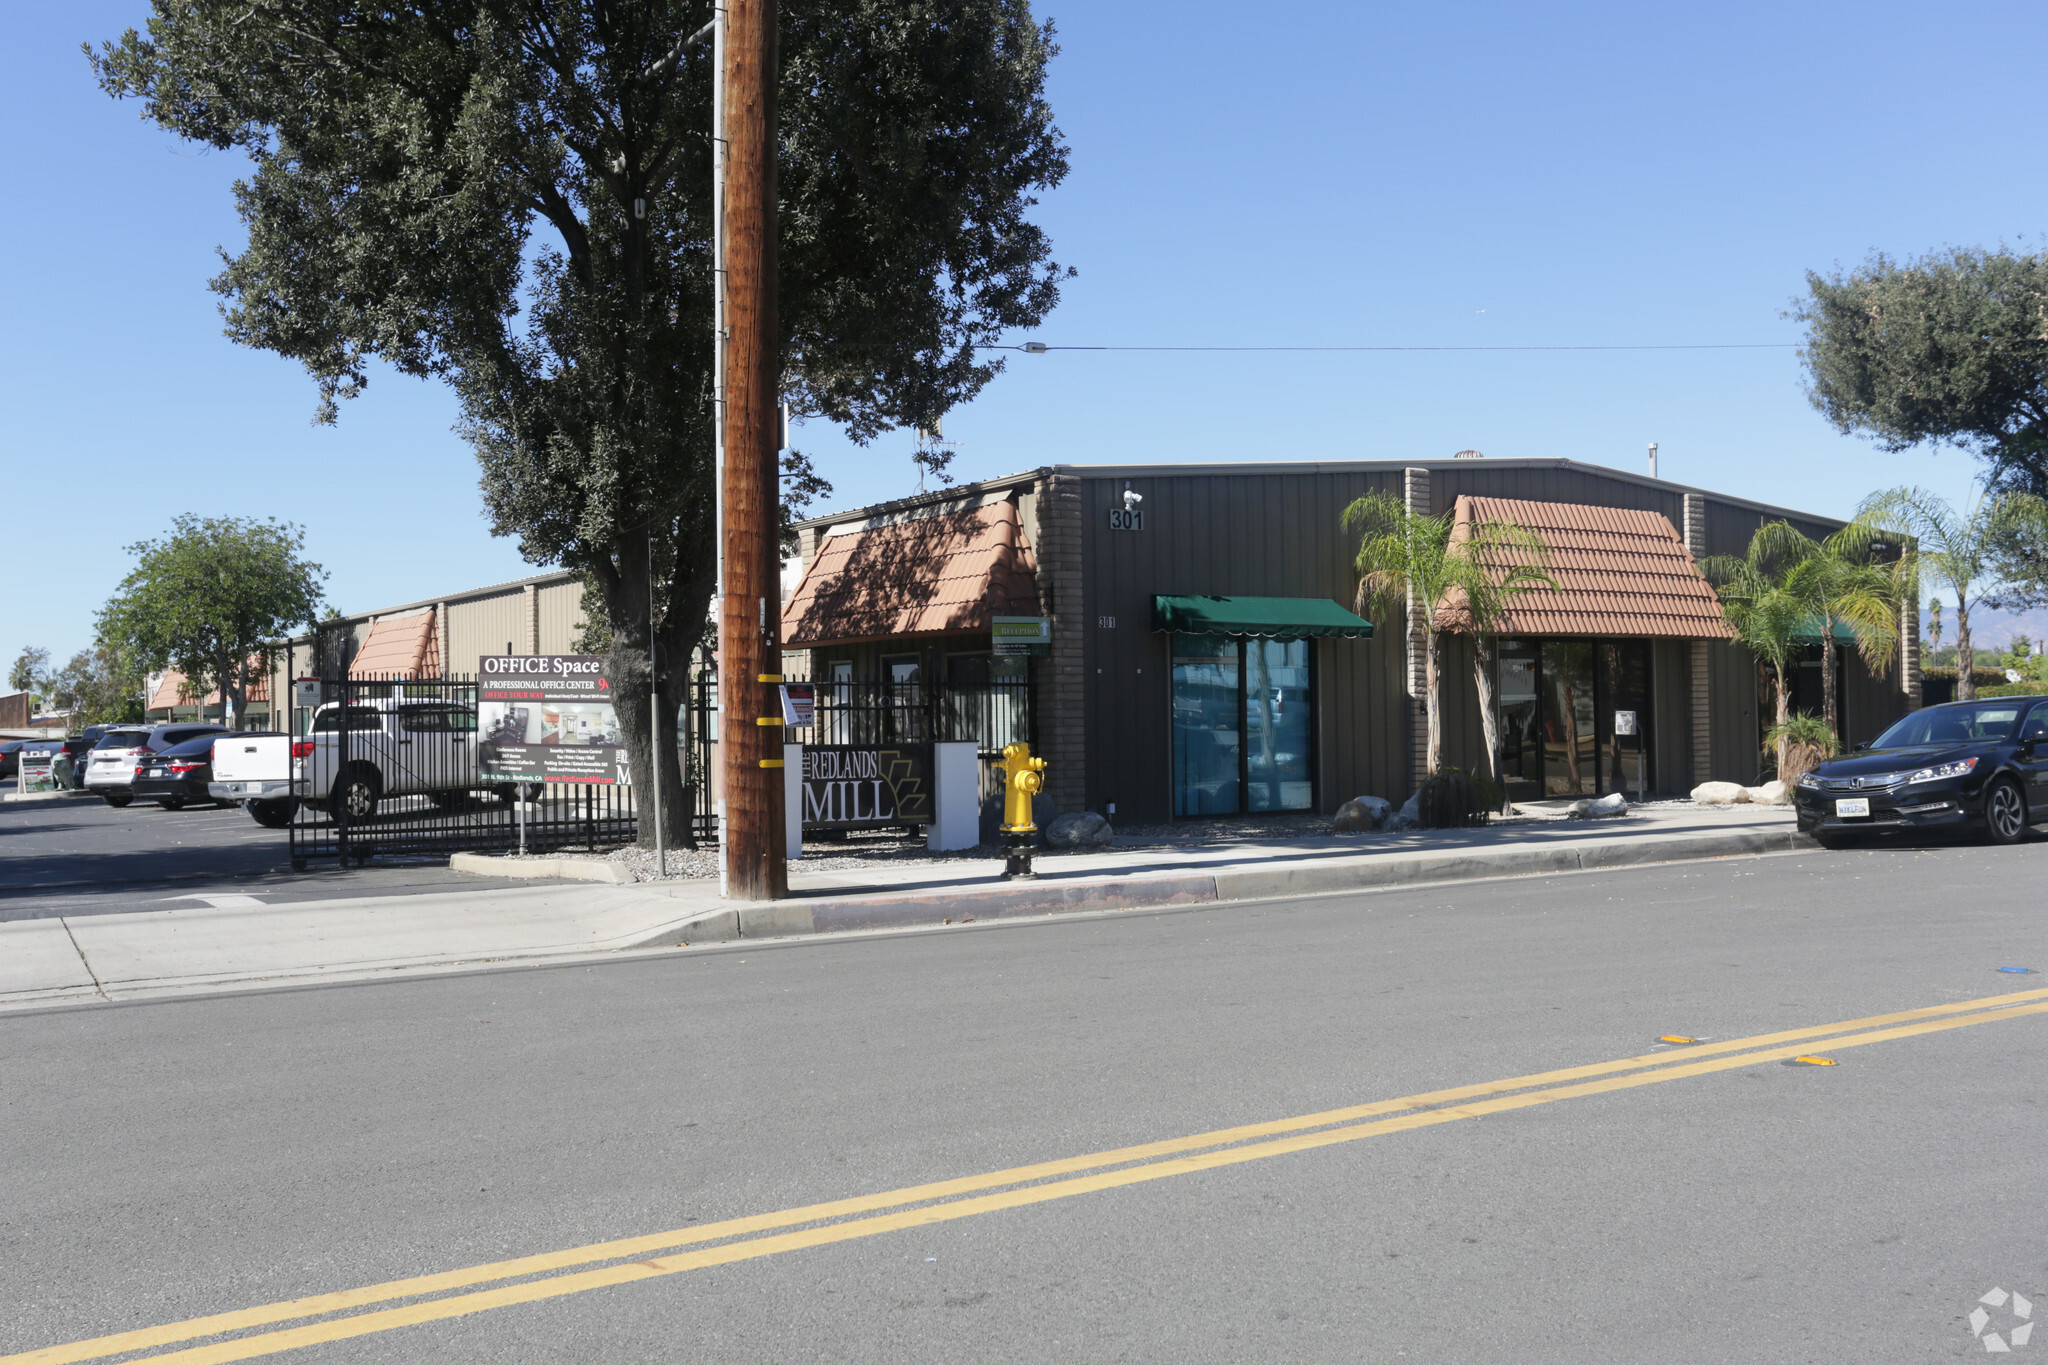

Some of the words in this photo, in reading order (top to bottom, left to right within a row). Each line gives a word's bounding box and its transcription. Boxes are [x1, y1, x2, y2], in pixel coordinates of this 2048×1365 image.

[1112, 510, 1142, 530] 301
[1100, 616, 1114, 628] 301
[485, 658, 549, 672] OFFICE
[553, 658, 599, 677] Space
[490, 681, 539, 689] PROFESSIONAL
[540, 681, 565, 689] OFFICE
[566, 681, 594, 689] CENTER
[802, 752, 810, 780] THE
[811, 751, 877, 779] REDLANDS
[544, 775, 614, 783] www.RedlandsMill.com
[802, 780, 894, 822] MILL
